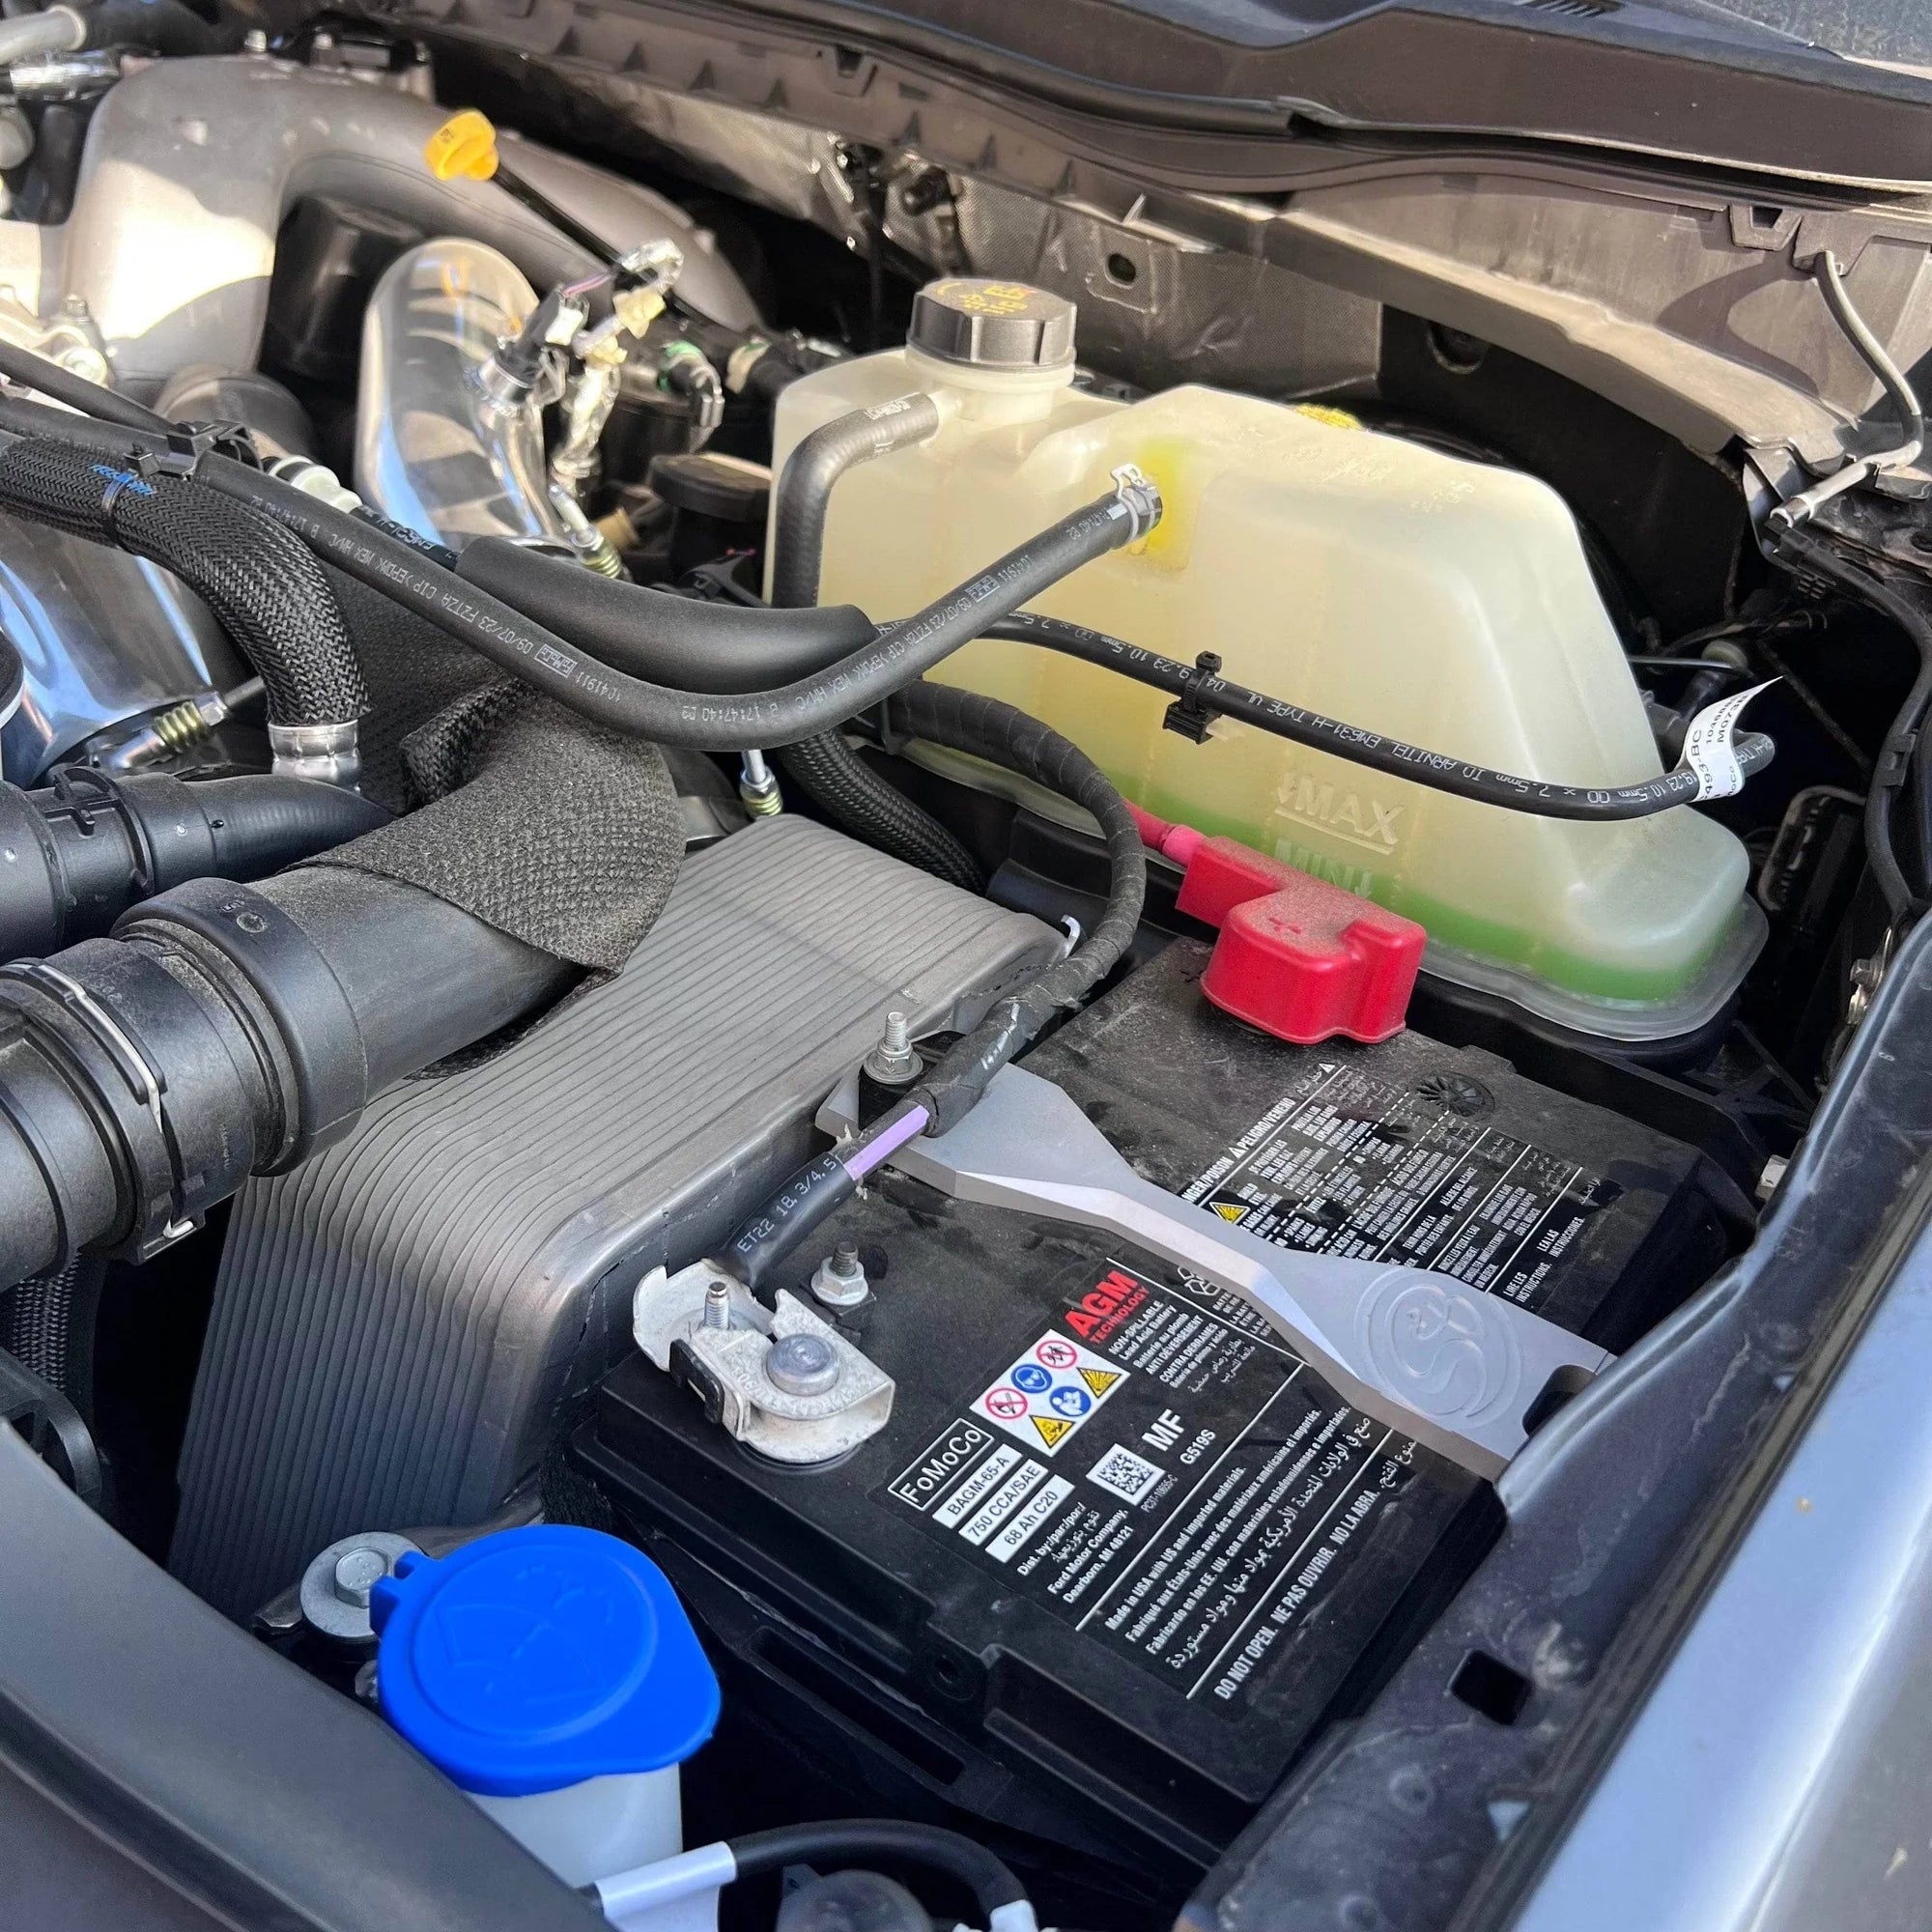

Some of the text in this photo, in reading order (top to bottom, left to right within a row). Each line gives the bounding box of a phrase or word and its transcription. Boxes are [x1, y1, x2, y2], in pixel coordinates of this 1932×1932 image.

[928, 597, 972, 630] 09/07/23
[478, 615, 534, 655] 09/07/23
[1152, 657, 1193, 679] 9.23
[1266, 700, 1306, 724] TYPE
[1311, 718, 1381, 749] EM631-H
[1391, 741, 1458, 771] ARNITEL
[1462, 766, 1487, 781] ID
[1495, 774, 1551, 797] 7.5mm
[1618, 783, 1666, 802] 10.5mm
[1294, 778, 1405, 844] MAX
[1181, 1155, 1234, 1202] NGER/POISON
[1236, 1097, 1295, 1150] PELIGRO/VENENO
[737, 1217, 775, 1253] ET22
[1536, 1229, 1559, 1251] LEA LAS
[1548, 1216, 1584, 1257] INSTRUCCIONES.
[1502, 1271, 1527, 1296] LIRE LES
[1515, 1262, 1551, 1302] INSTRUCTIONS.
[1065, 1270, 1137, 1336] AGM
[1090, 1286, 1148, 1343] TECHNOLOGY
[1108, 1300, 1163, 1354] NON-SPILLABLE
[1118, 1304, 1177, 1360] Lead Acid Battery
[1132, 1341, 1161, 1368] Batterie
[1166, 1313, 1189, 1335] plomb
[1145, 1356, 1164, 1375] ANTI
[1159, 1322, 1218, 1382] CONTRA DERRAMES
[1142, 1408, 1183, 1451] MF
[1314, 1406, 1350, 1443] importados.
[1342, 1434, 1362, 1447] في
[1353, 1417, 1371, 1438] صنع
[1179, 1429, 1215, 1463] G519S
[1318, 1441, 1349, 1477] الولايات
[899, 1430, 980, 1502] FoMoCo
[1267, 1448, 1316, 1503] estadounidenses
[947, 1458, 1009, 1515] BAGM-65-A
[968, 1465, 1039, 1537] 750 CCA/SAE
[1291, 1474, 1322, 1507] المتحدة
[1004, 1491, 1058, 1545] 68 Ah C20
[1124, 1409, 1321, 1641] Fabriqué aux États-Unis avec des matériaux américains et importés.
[1236, 1501, 1272, 1542] materiales
[1016, 1555, 1040, 1576] Dist.
[1047, 1509, 1128, 1594] Ford Motor Company,
[1063, 1525, 1133, 1603] Dearborn, MI 48121
[1104, 1466, 1246, 1630] Made in USA with US and imported materials.
[1210, 1556, 1230, 1573] UU.
[1225, 1540, 1241, 1557] con
[1188, 1584, 1207, 1600] los
[1199, 1572, 1217, 1586] EE.
[1213, 1490, 1379, 1699] DO NOT OPEN. NE PAS OUVRIR. NO LA ABRA.
[1182, 1597, 1196, 1610] en
